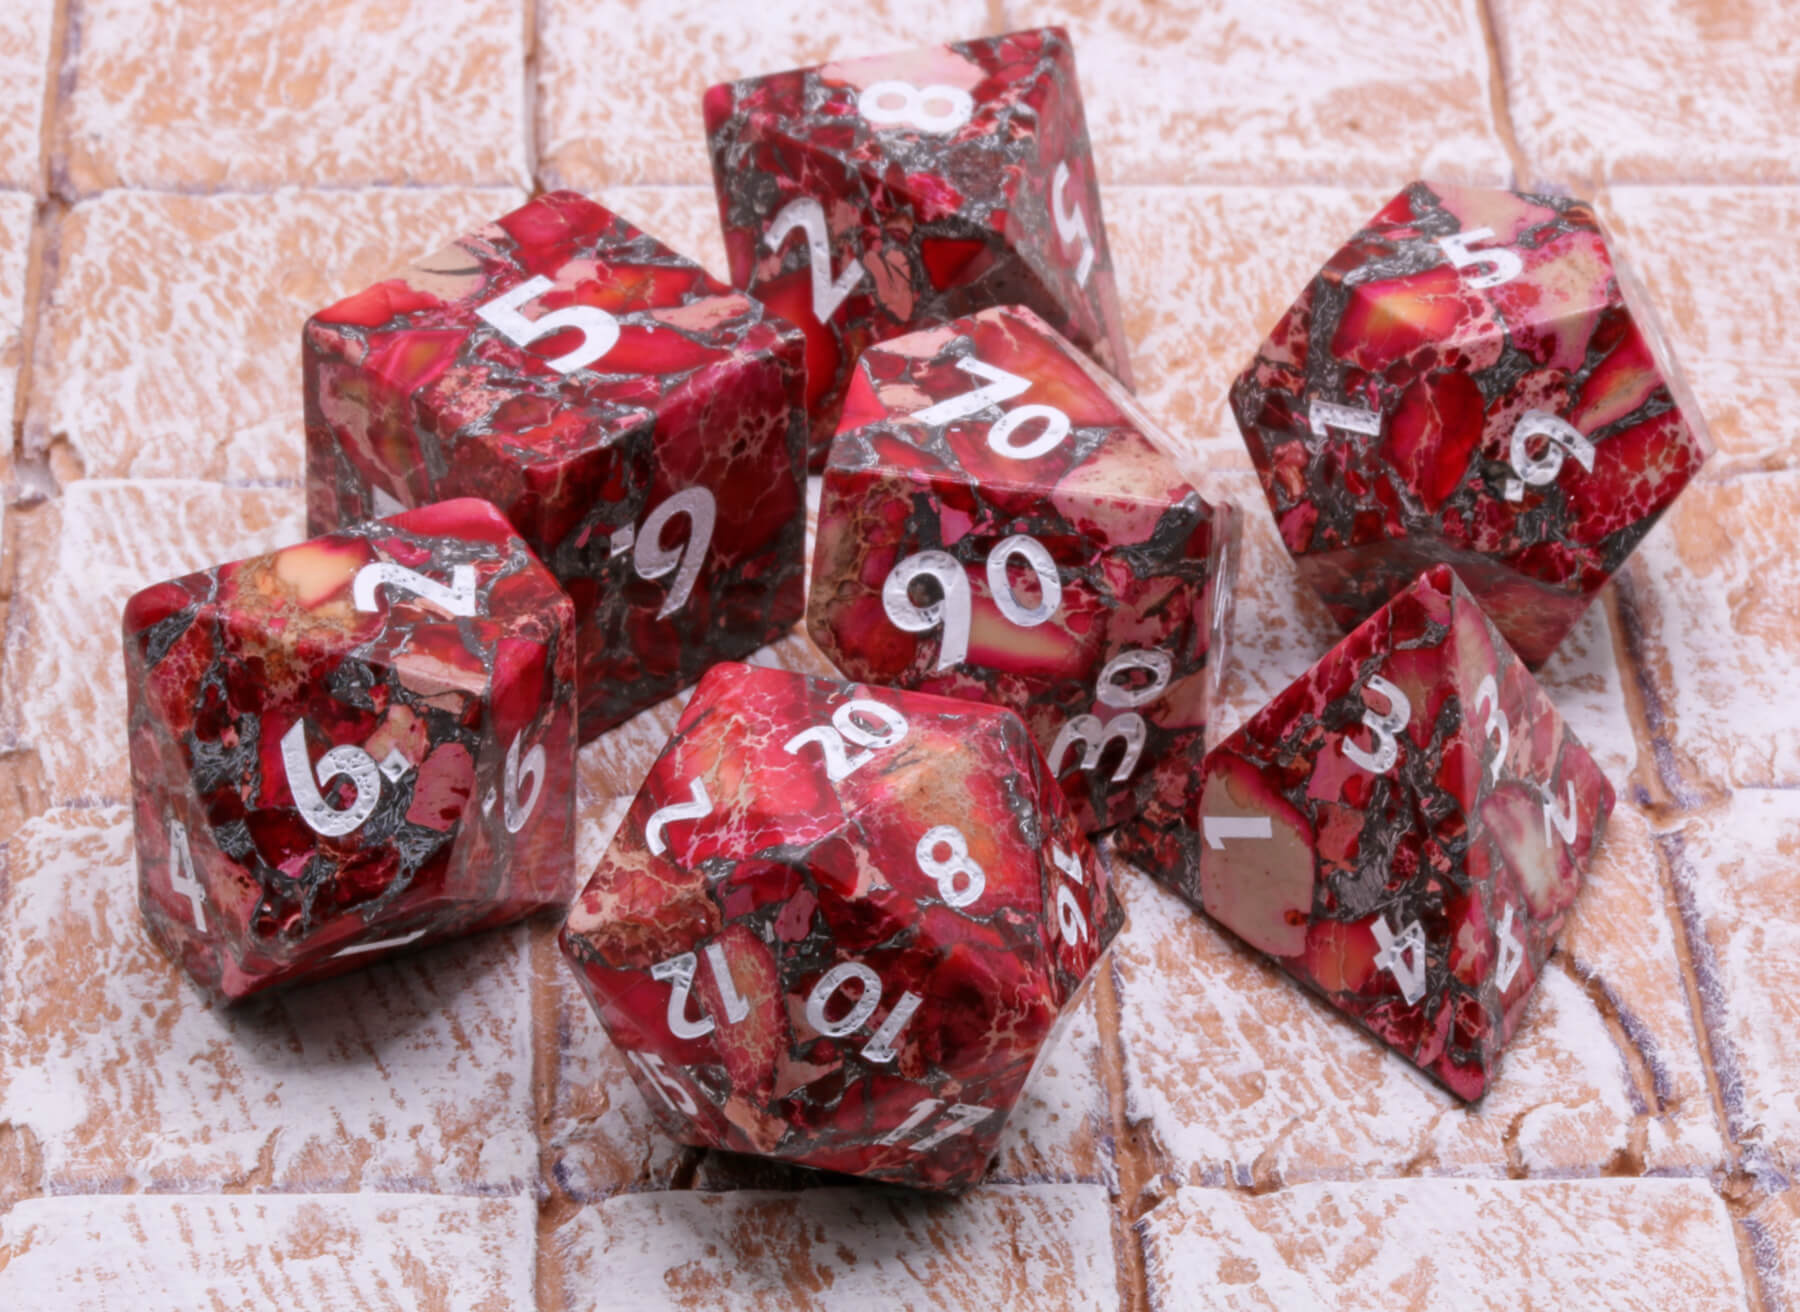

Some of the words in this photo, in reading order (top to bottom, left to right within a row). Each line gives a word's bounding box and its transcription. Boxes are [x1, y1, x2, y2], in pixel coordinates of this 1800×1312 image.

[858, 80, 974, 134] 8
[765, 198, 865, 324] 2
[1440, 226, 1523, 289] 5
[475, 274, 620, 374] 5
[354, 562, 476, 617] 2
[881, 535, 1062, 672] 90
[784, 699, 908, 782] 20
[1047, 649, 1172, 782] 30
[1342, 674, 1411, 774] 3
[1475, 673, 1509, 788] 3
[170, 819, 207, 933] 4
[915, 825, 986, 908] 8
[1203, 816, 1272, 850] 1
[651, 942, 750, 1041] 12
[1370, 914, 1426, 1007] 4
[1495, 902, 1524, 993] 4
[806, 961, 924, 1063] 10
[878, 1099, 994, 1153] 17
